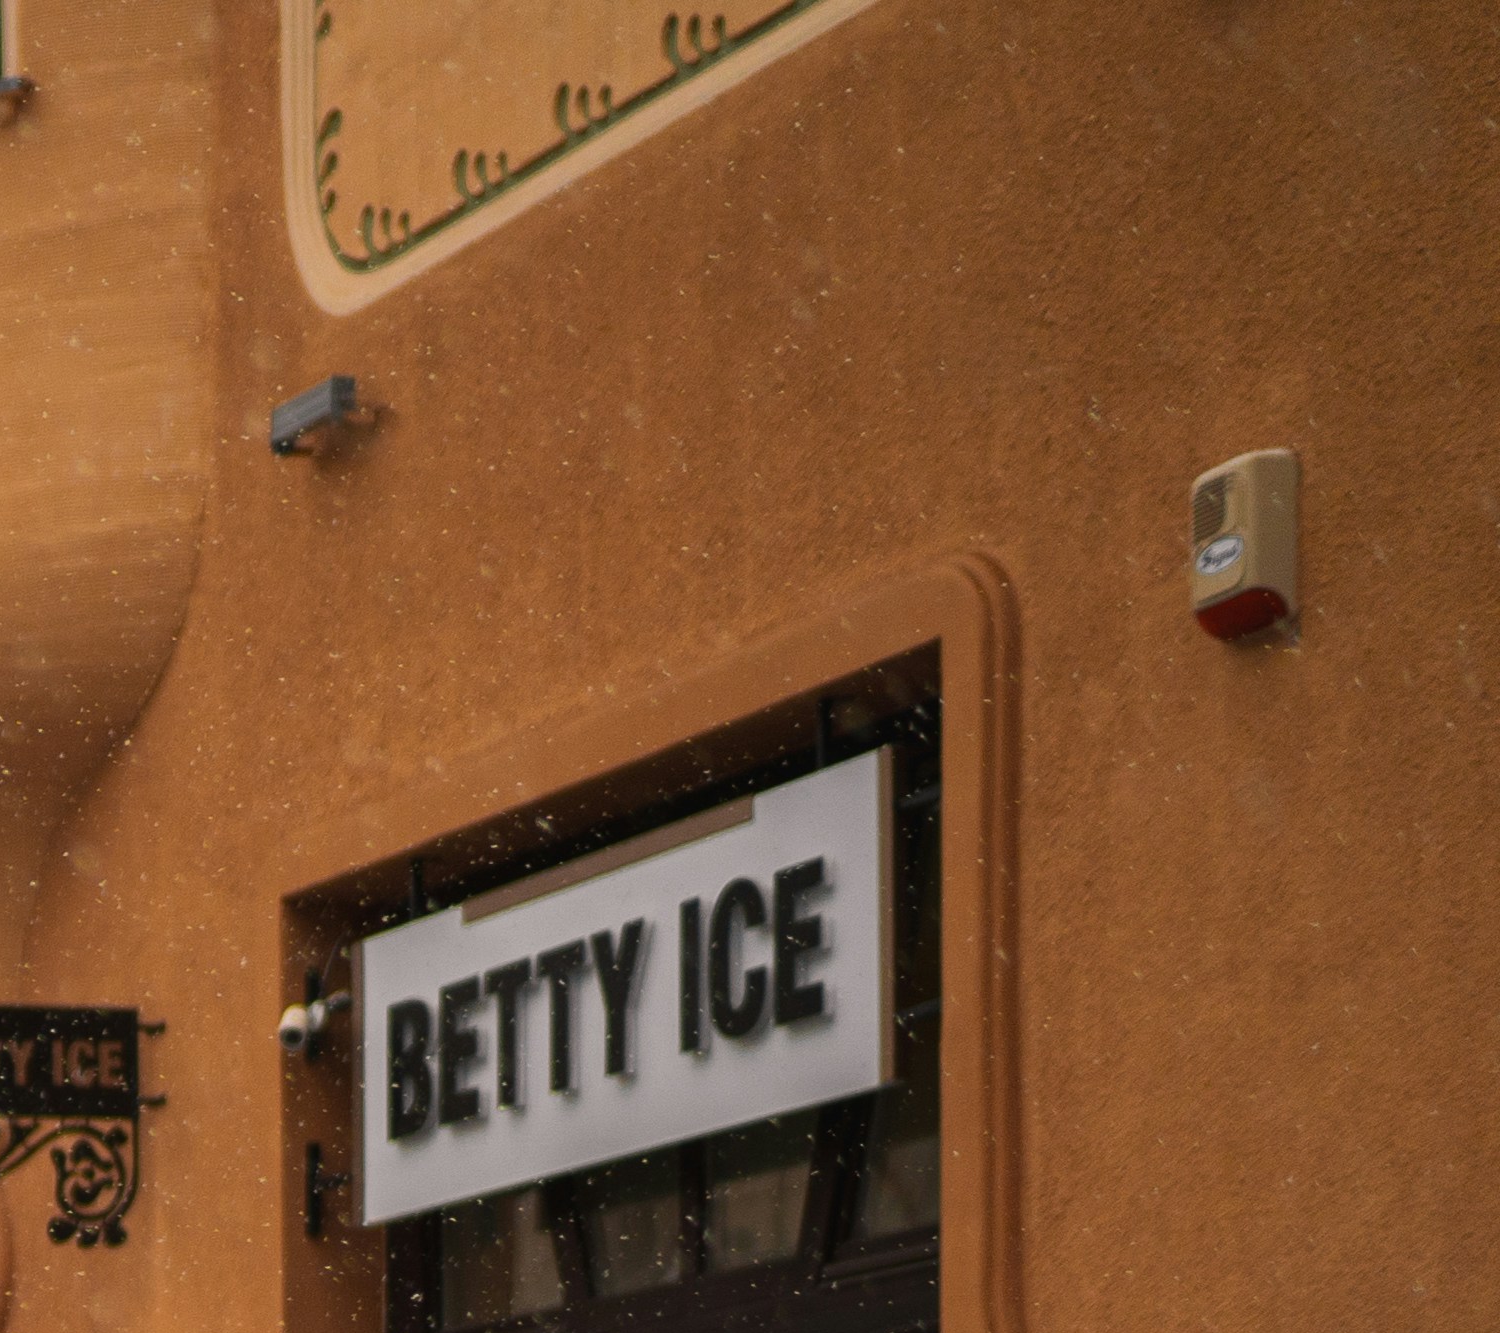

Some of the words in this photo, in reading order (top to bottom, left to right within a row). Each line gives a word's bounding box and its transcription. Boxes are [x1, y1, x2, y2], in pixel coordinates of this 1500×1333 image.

[51, 1038, 125, 1089] ICE
[387, 919, 646, 1143] BETTY
[679, 856, 826, 1054] ICE
